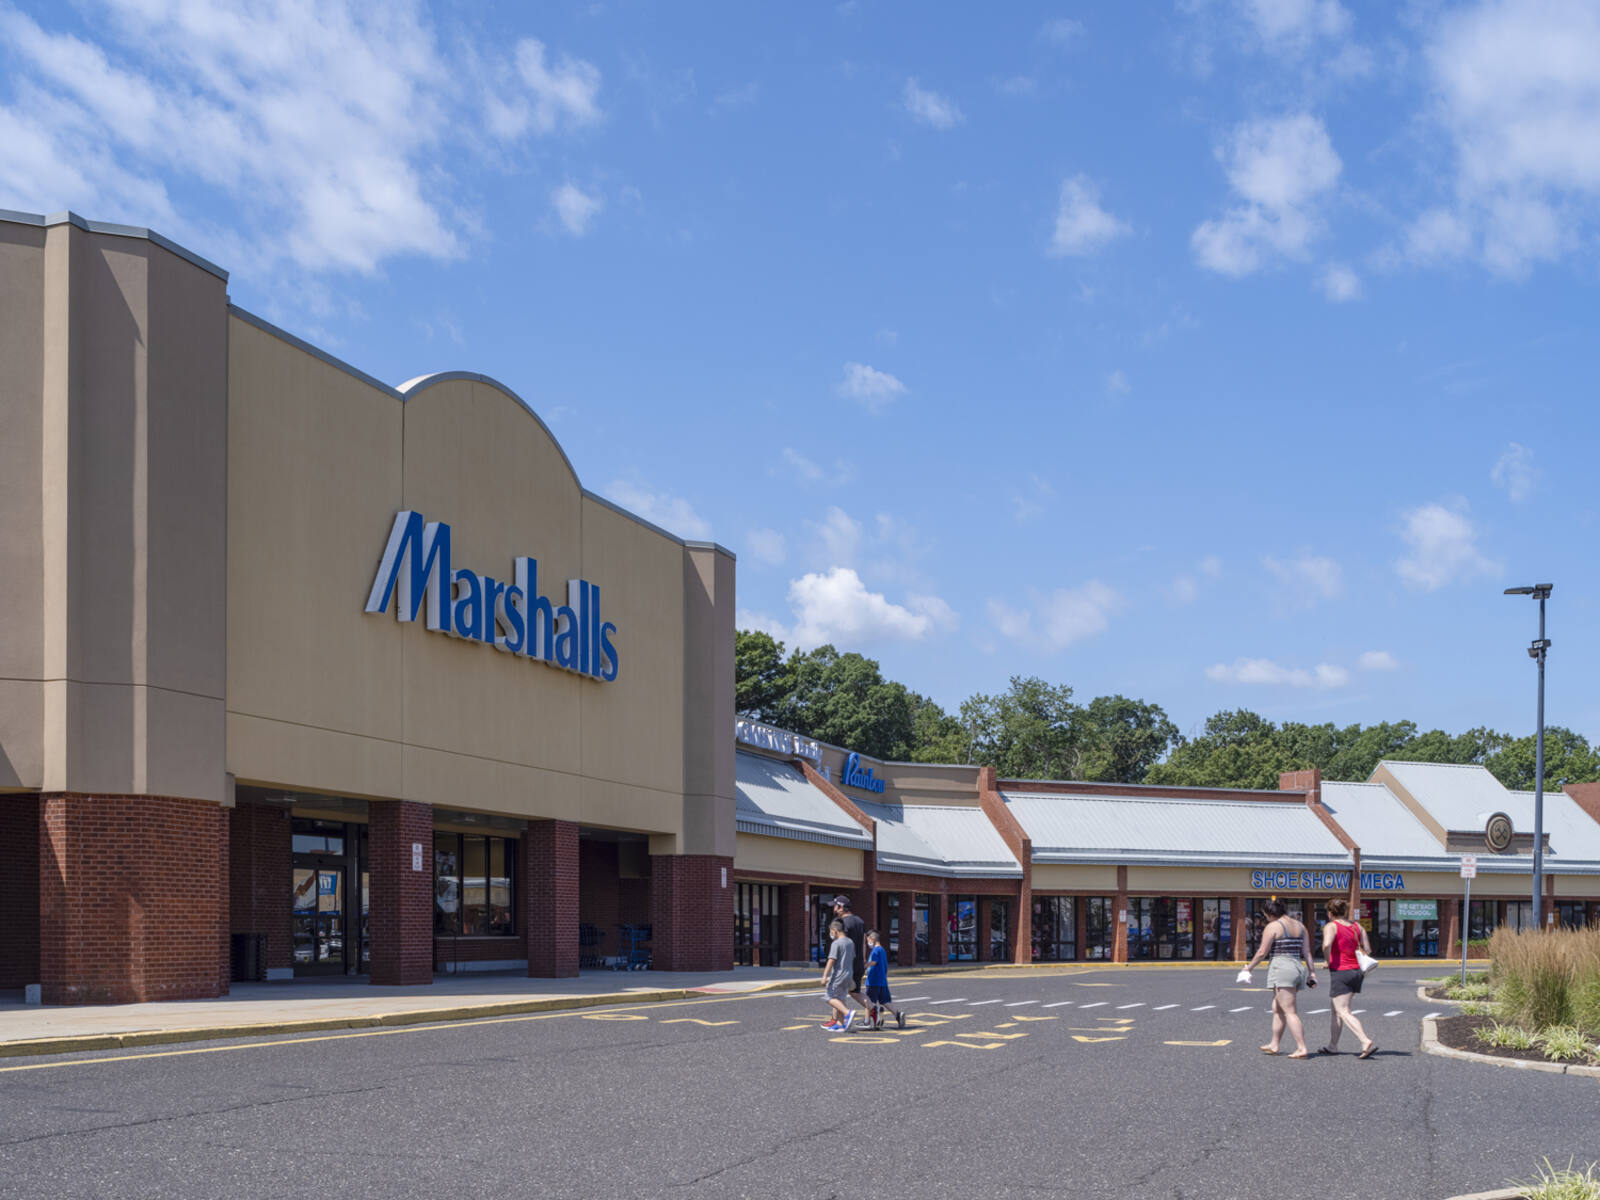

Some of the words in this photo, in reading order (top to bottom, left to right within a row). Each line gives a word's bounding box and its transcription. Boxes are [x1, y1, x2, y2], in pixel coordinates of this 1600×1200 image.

[365, 510, 619, 682] Marshalls
[1252, 870, 1298, 889] SHOE
[1301, 871, 1350, 889] SHOW
[1360, 873, 1405, 889] MEGA
